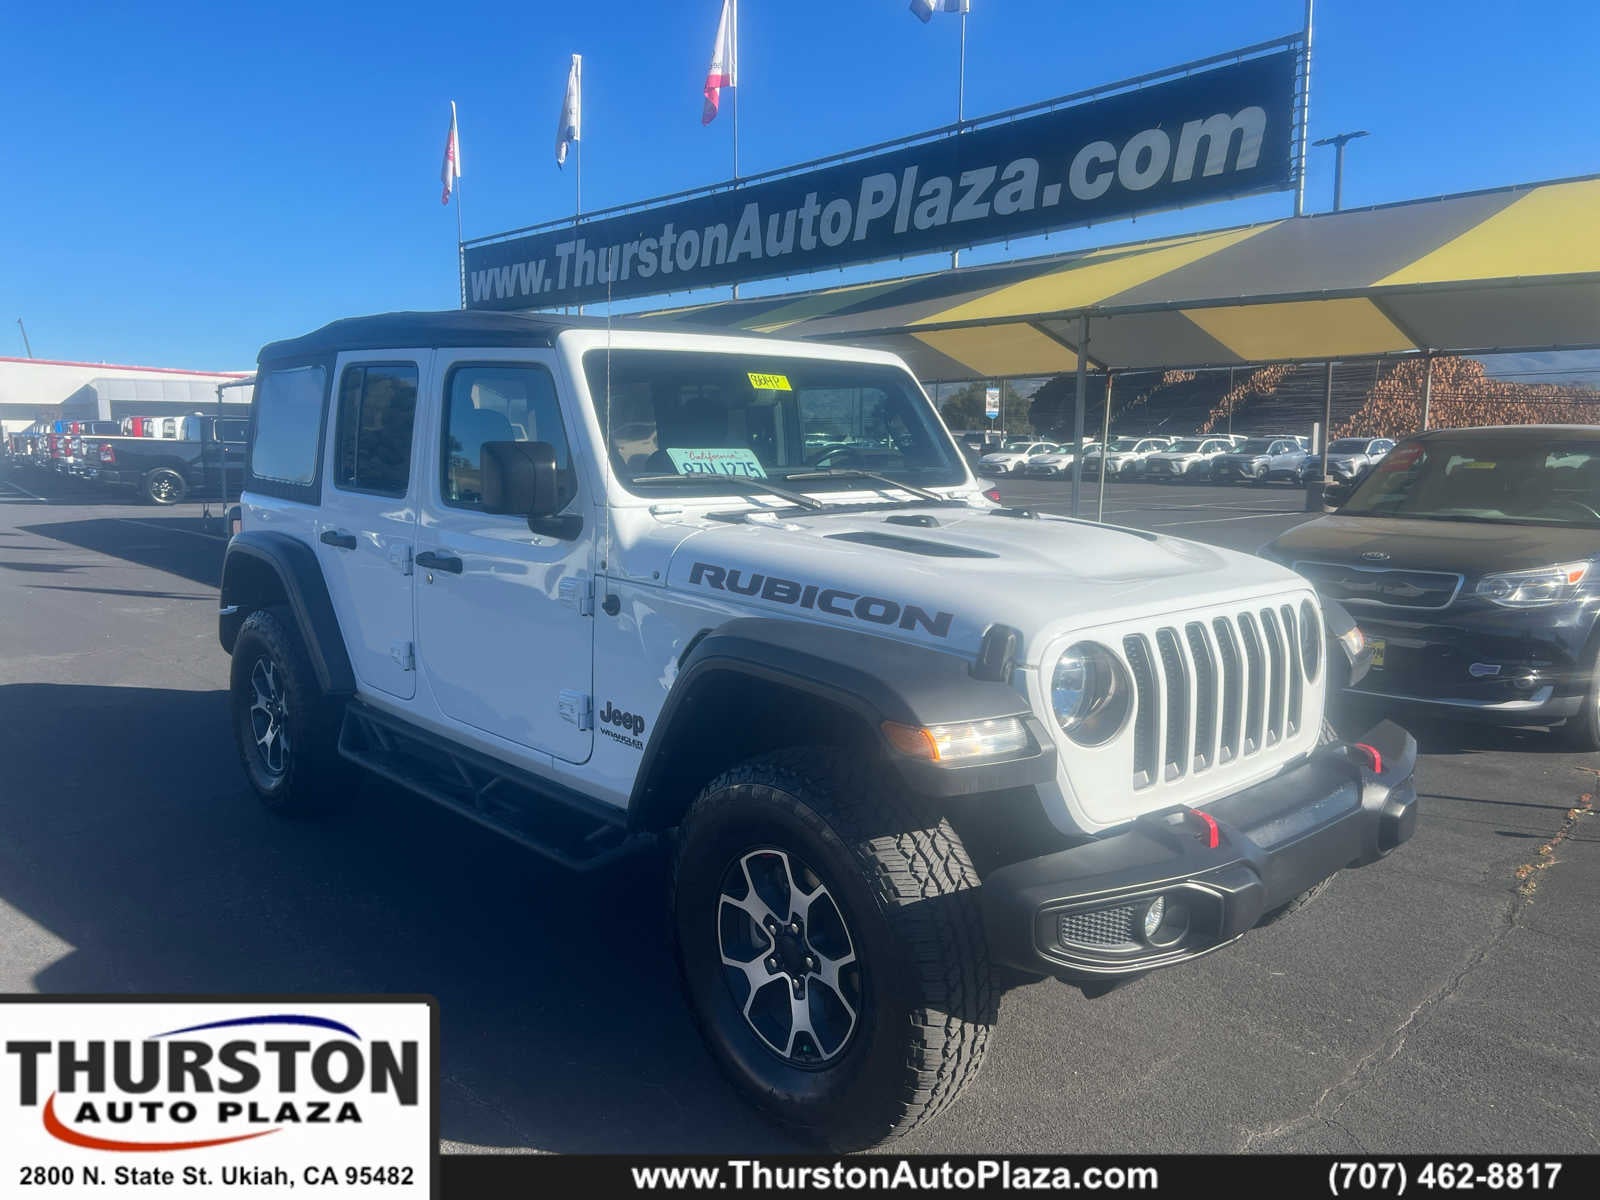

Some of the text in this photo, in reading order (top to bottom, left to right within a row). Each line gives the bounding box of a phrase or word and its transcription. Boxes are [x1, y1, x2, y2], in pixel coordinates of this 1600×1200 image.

[471, 105, 1267, 302] www.ThurstonAutoPlaza.com
[689, 562, 954, 638] RUBICON
[600, 701, 645, 737] Jeep
